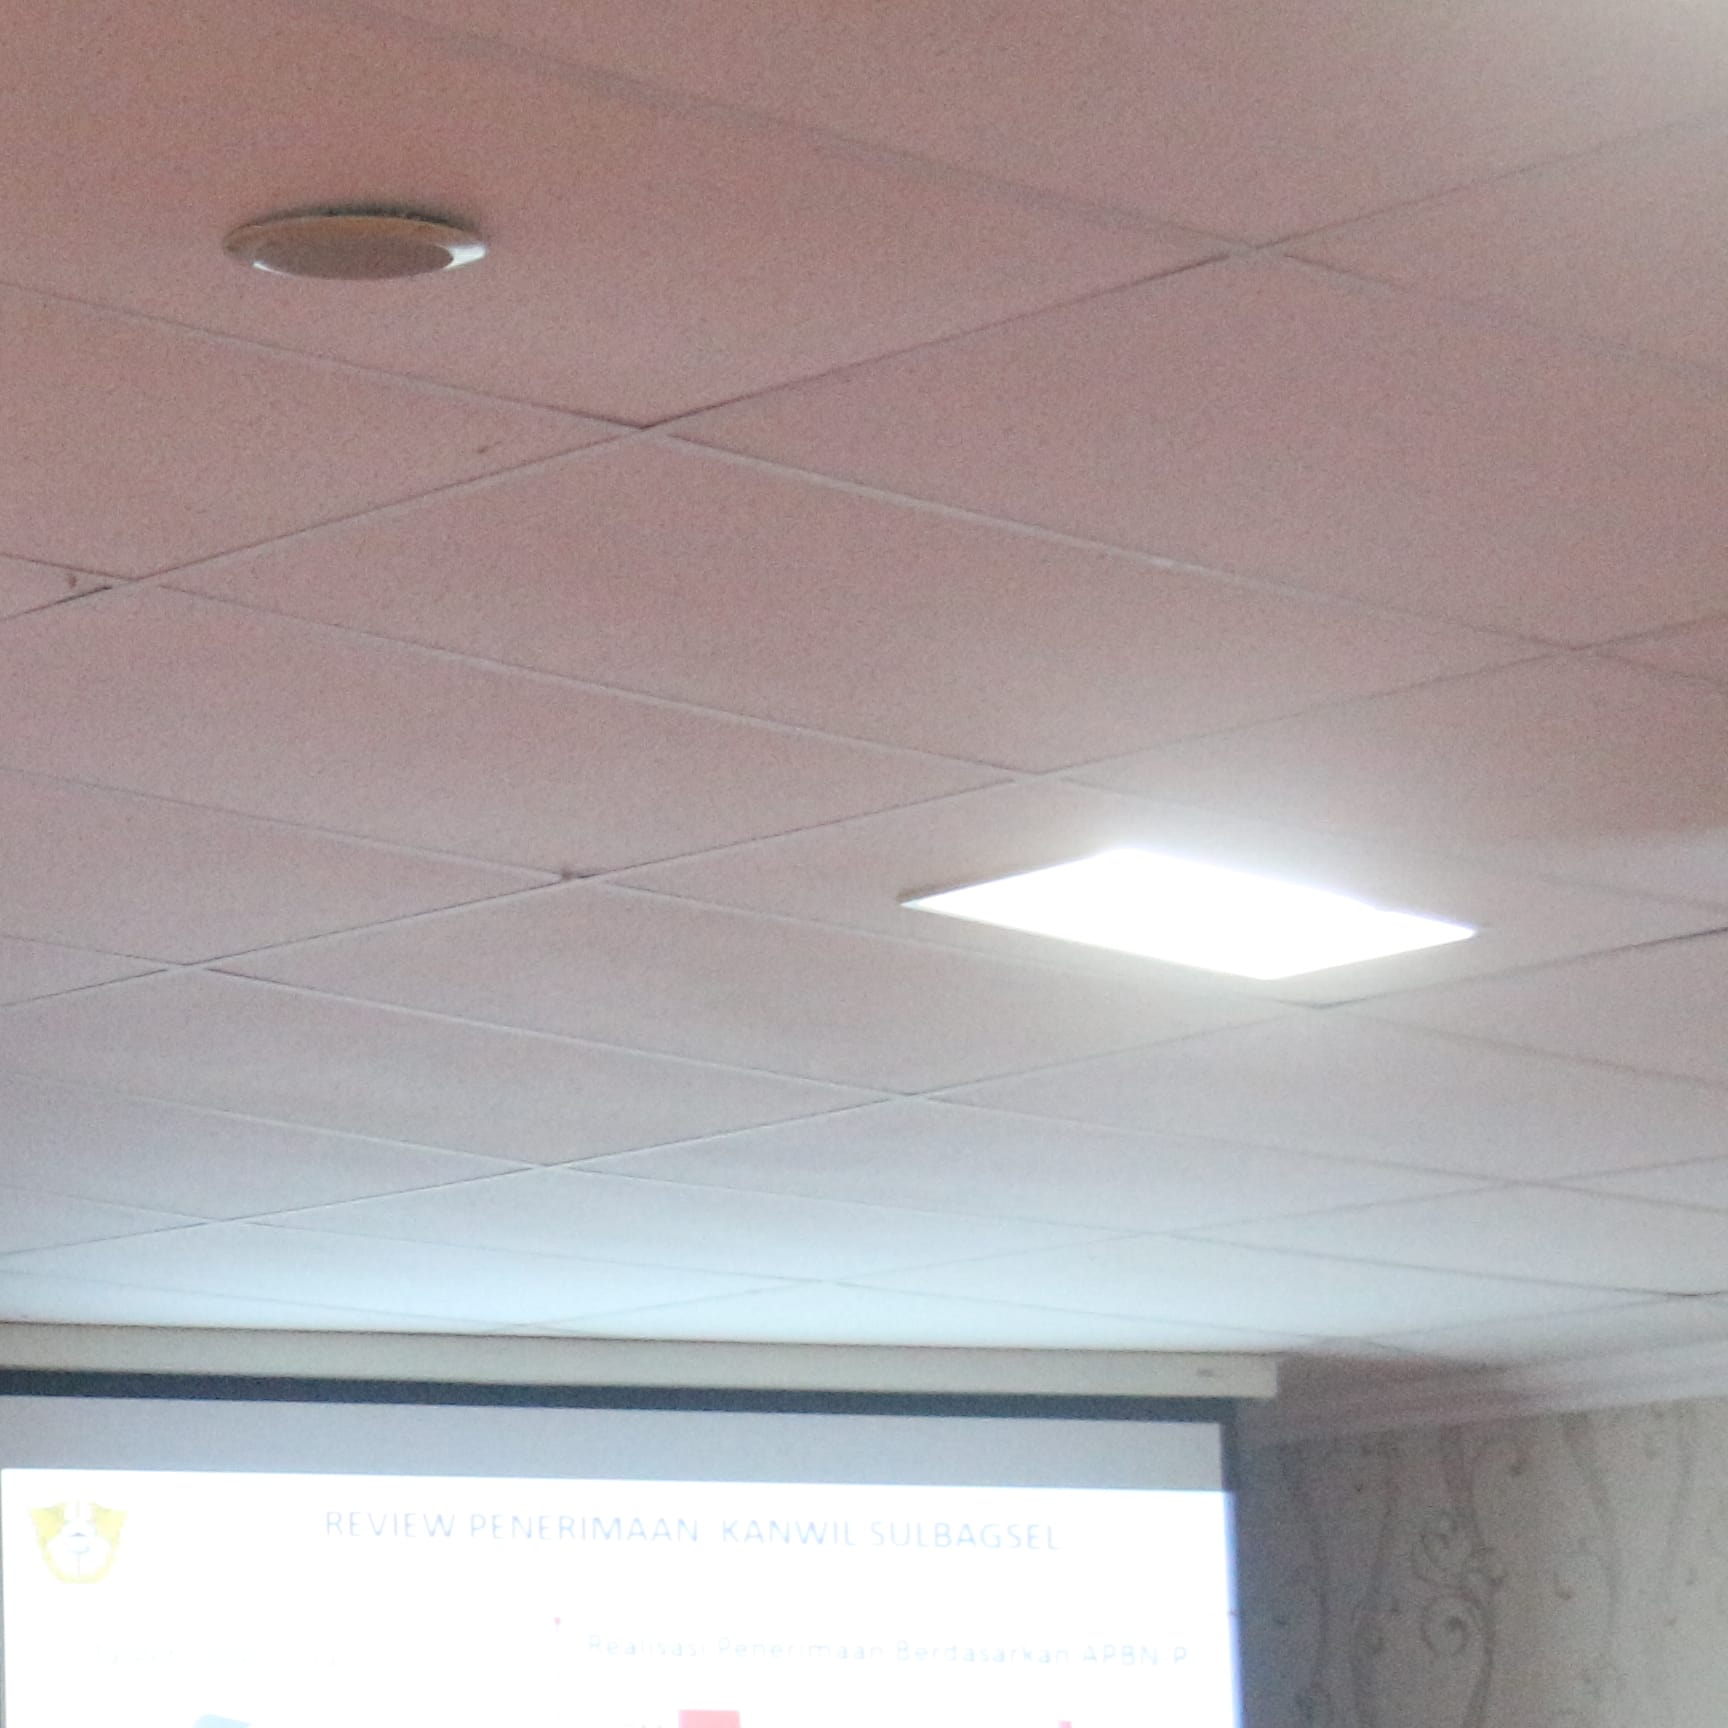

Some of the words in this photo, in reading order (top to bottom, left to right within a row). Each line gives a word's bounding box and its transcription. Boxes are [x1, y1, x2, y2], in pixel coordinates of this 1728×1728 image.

[325, 1510, 455, 1540] REVIEW
[470, 1513, 699, 1544] PENERIMAAN
[721, 1518, 858, 1547] KANWIL
[870, 1520, 1061, 1551] SULBAGSEL
